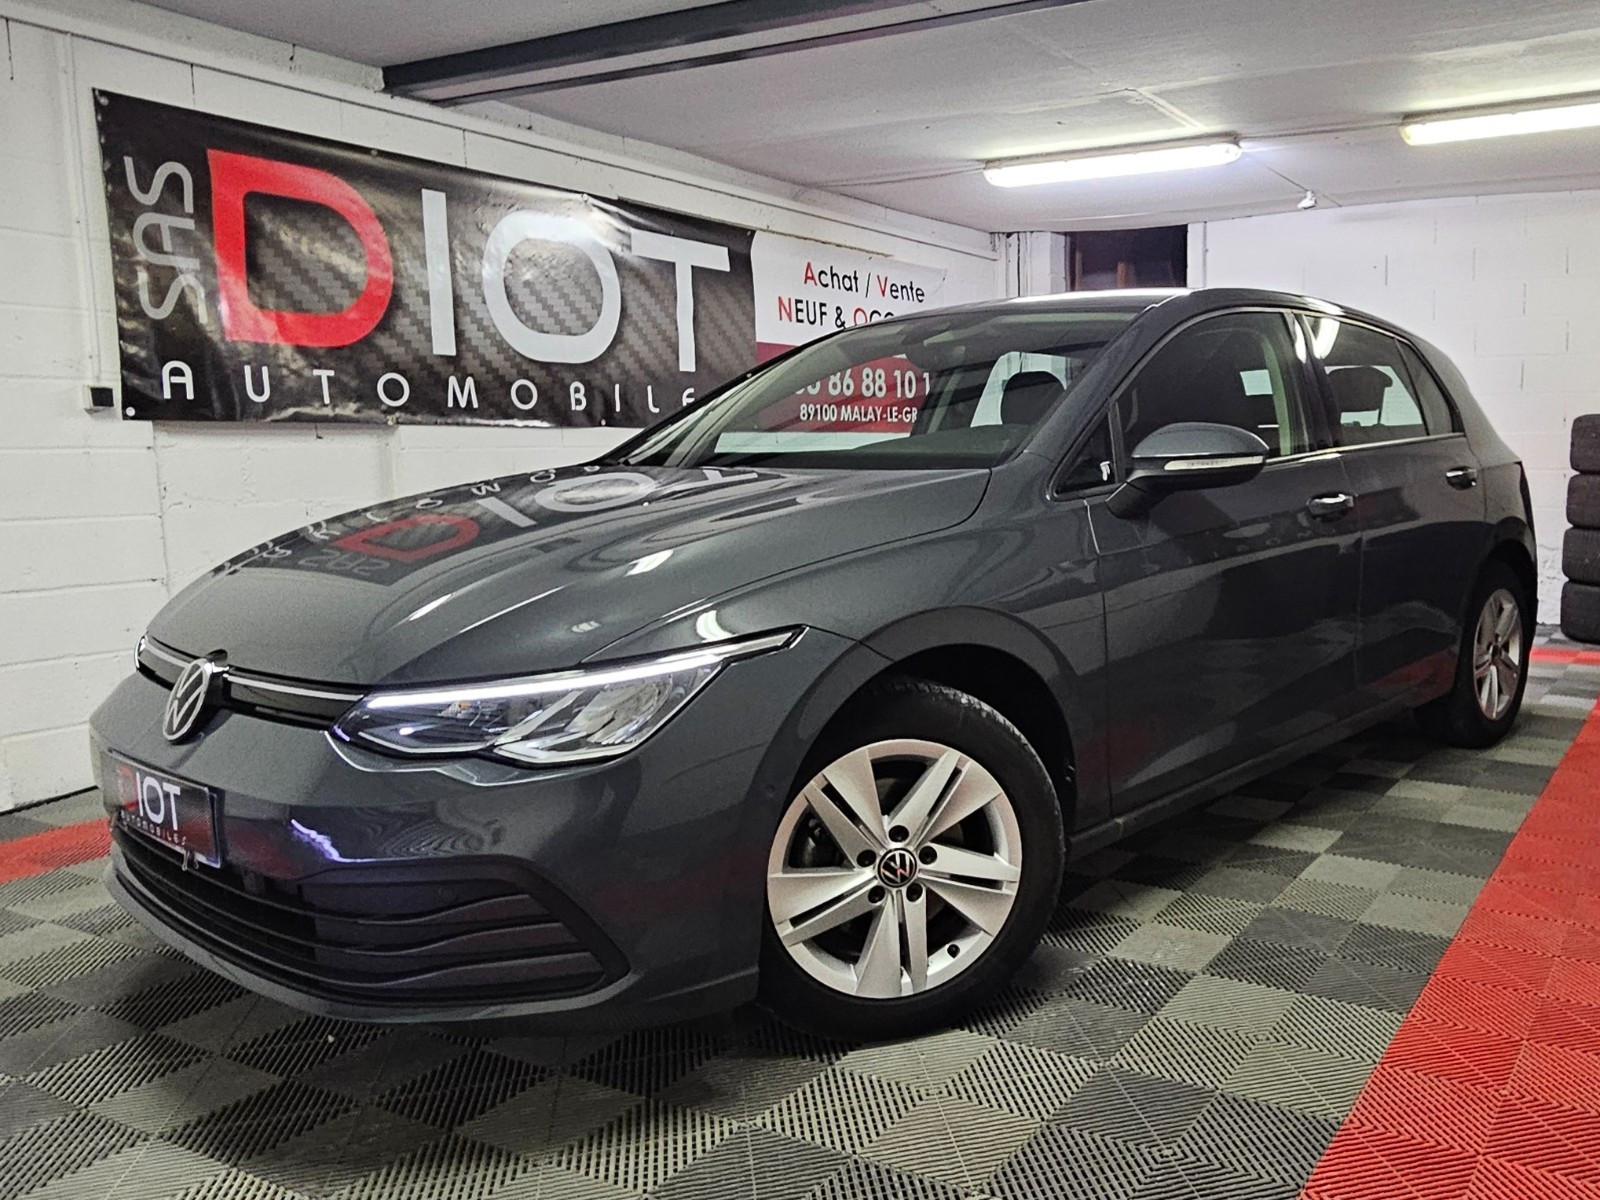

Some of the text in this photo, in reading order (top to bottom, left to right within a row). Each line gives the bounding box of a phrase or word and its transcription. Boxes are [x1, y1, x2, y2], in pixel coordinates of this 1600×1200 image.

[123, 155, 208, 325] SAS
[207, 149, 730, 373] DIOT
[804, 261, 859, 293] Achat
[877, 274, 925, 303] Vente
[778, 296, 827, 326] NEUF
[835, 305, 847, 330] &
[162, 360, 696, 414] AUTOMOBILE
[828, 368, 855, 397] 86
[861, 367, 887, 398] 88
[893, 370, 917, 399] 10
[922, 372, 931, 397] 1
[800, 403, 918, 423] 89100 MALAY-LE-GR
